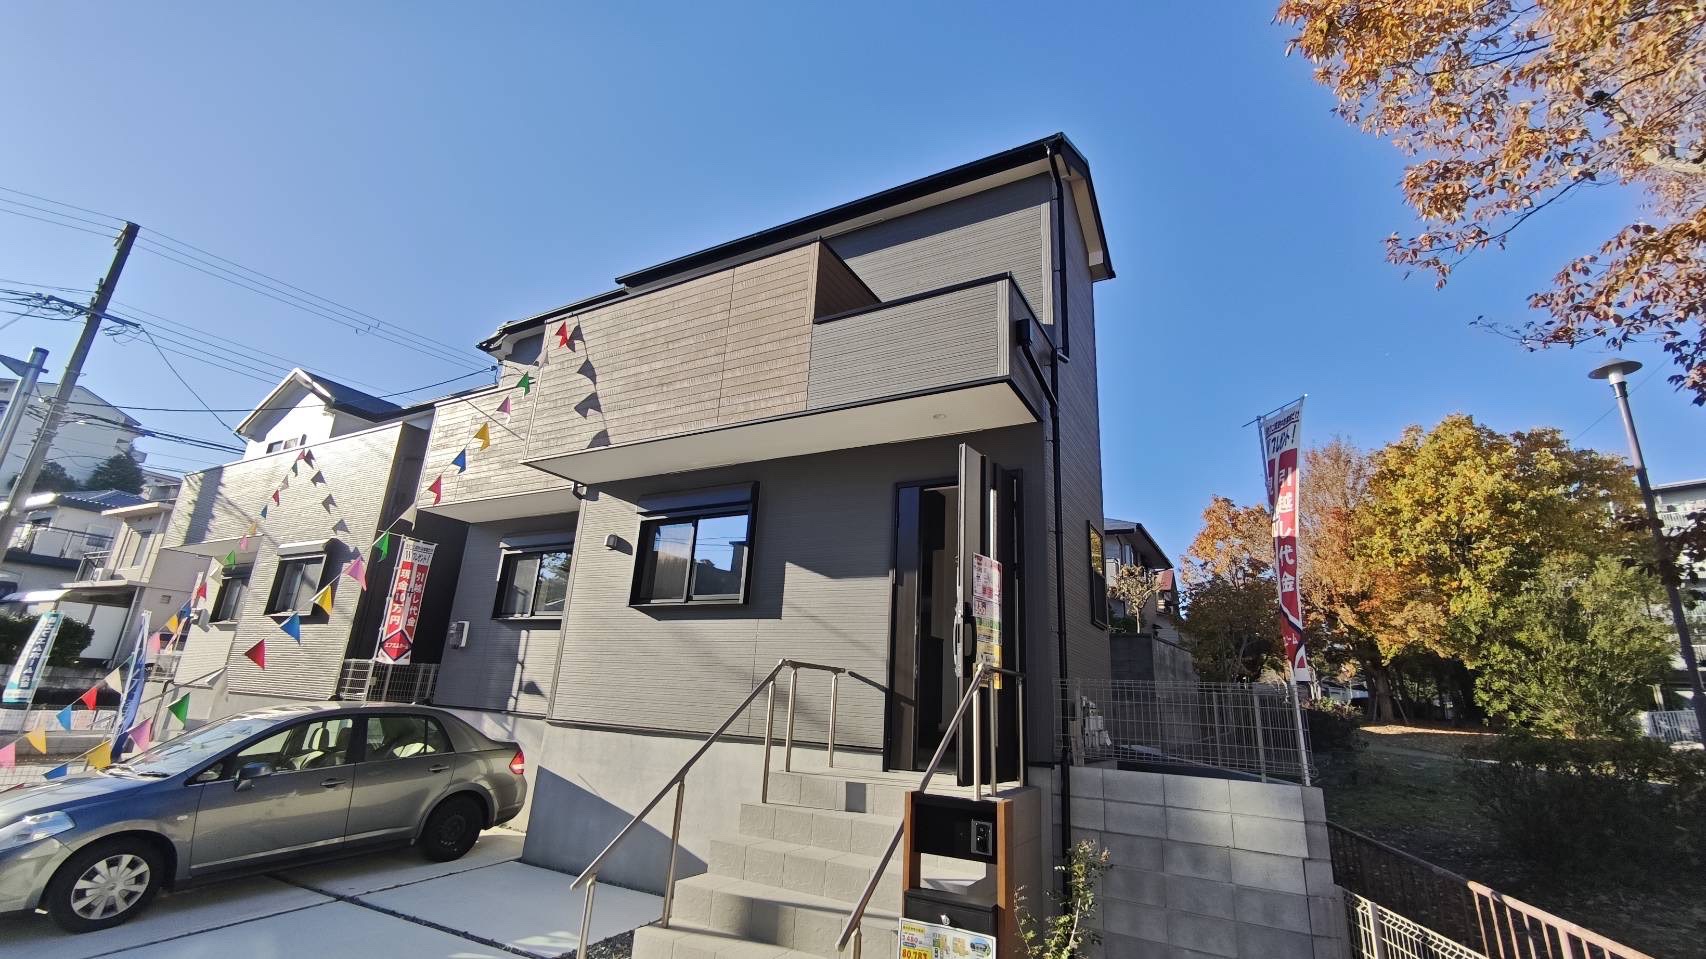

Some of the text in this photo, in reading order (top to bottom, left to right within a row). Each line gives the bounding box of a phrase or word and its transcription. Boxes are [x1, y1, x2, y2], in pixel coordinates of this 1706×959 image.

[1277, 466, 1295, 592] 引越し代金
[389, 569, 411, 625] 現金10万円
[407, 572, 425, 627] 引越し代金
